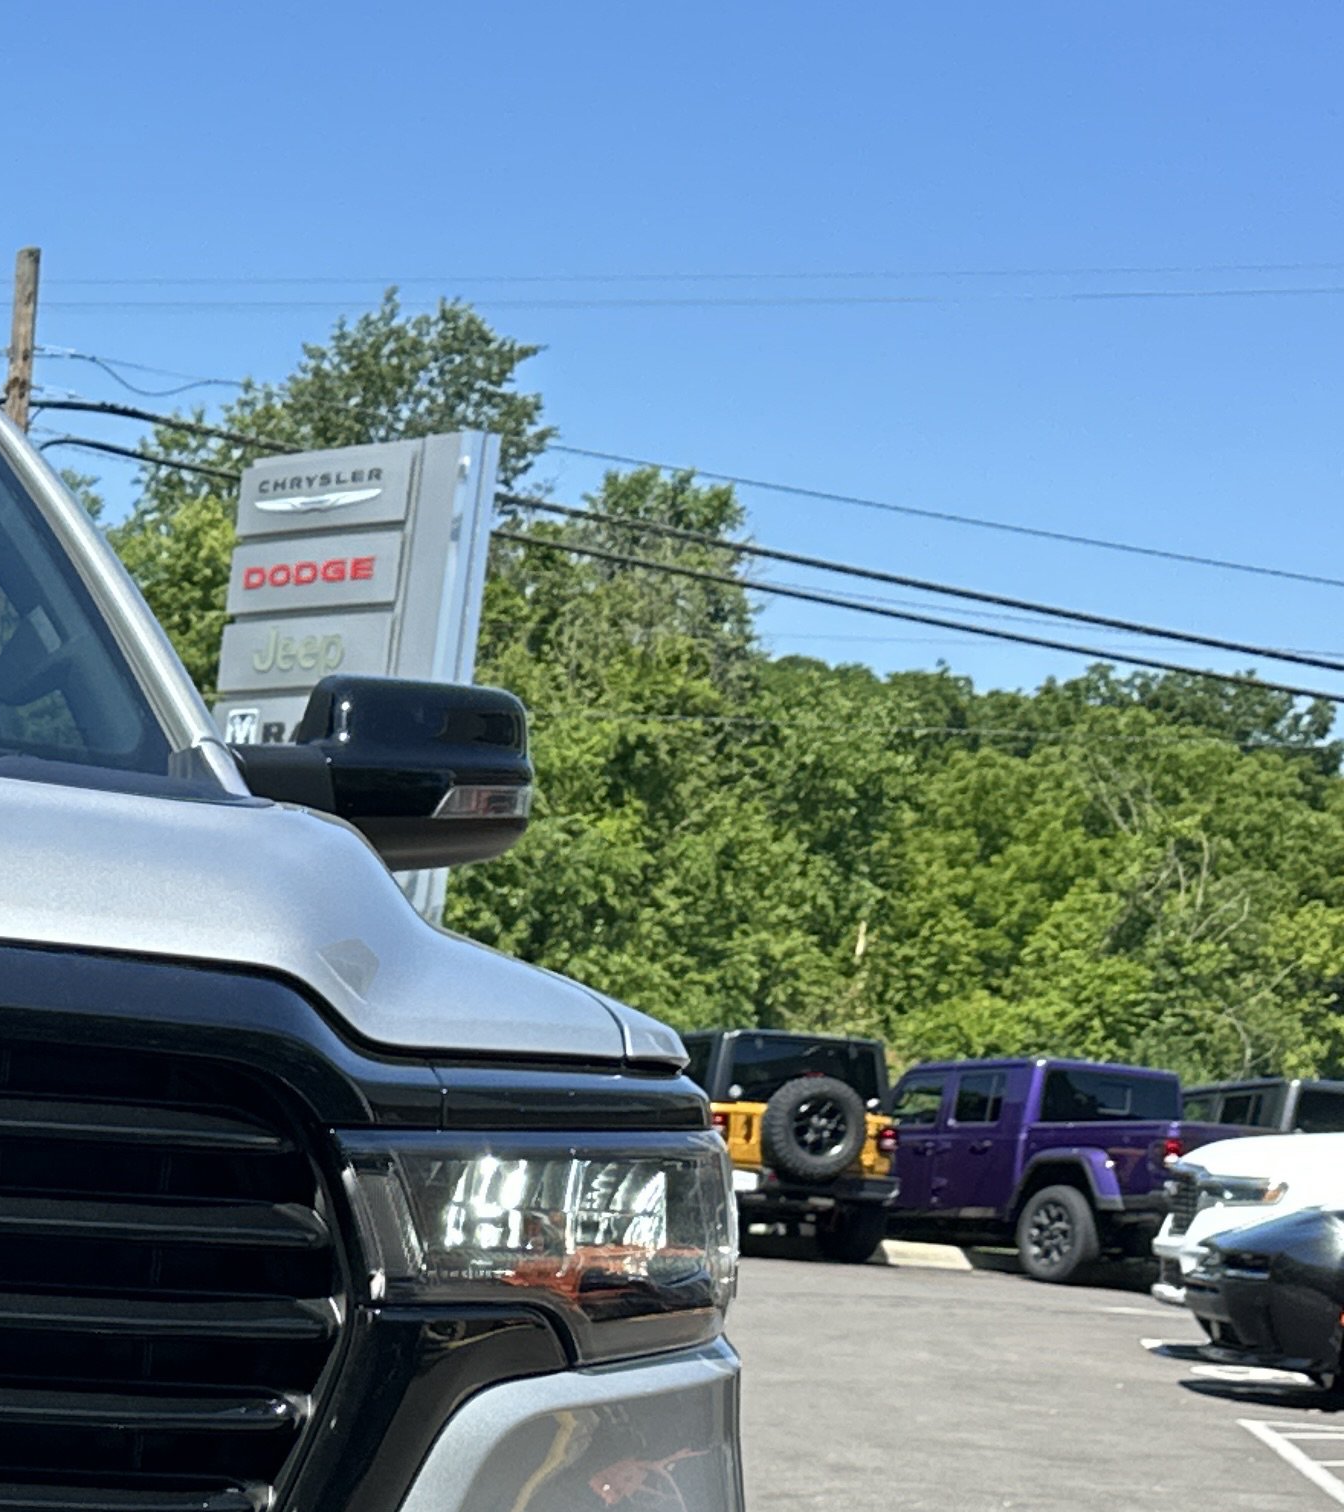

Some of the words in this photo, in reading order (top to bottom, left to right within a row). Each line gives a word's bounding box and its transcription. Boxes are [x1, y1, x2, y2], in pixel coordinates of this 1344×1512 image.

[258, 467, 383, 493] CHRYSLER
[243, 556, 375, 590] DODGE
[252, 626, 345, 676] Jeep
